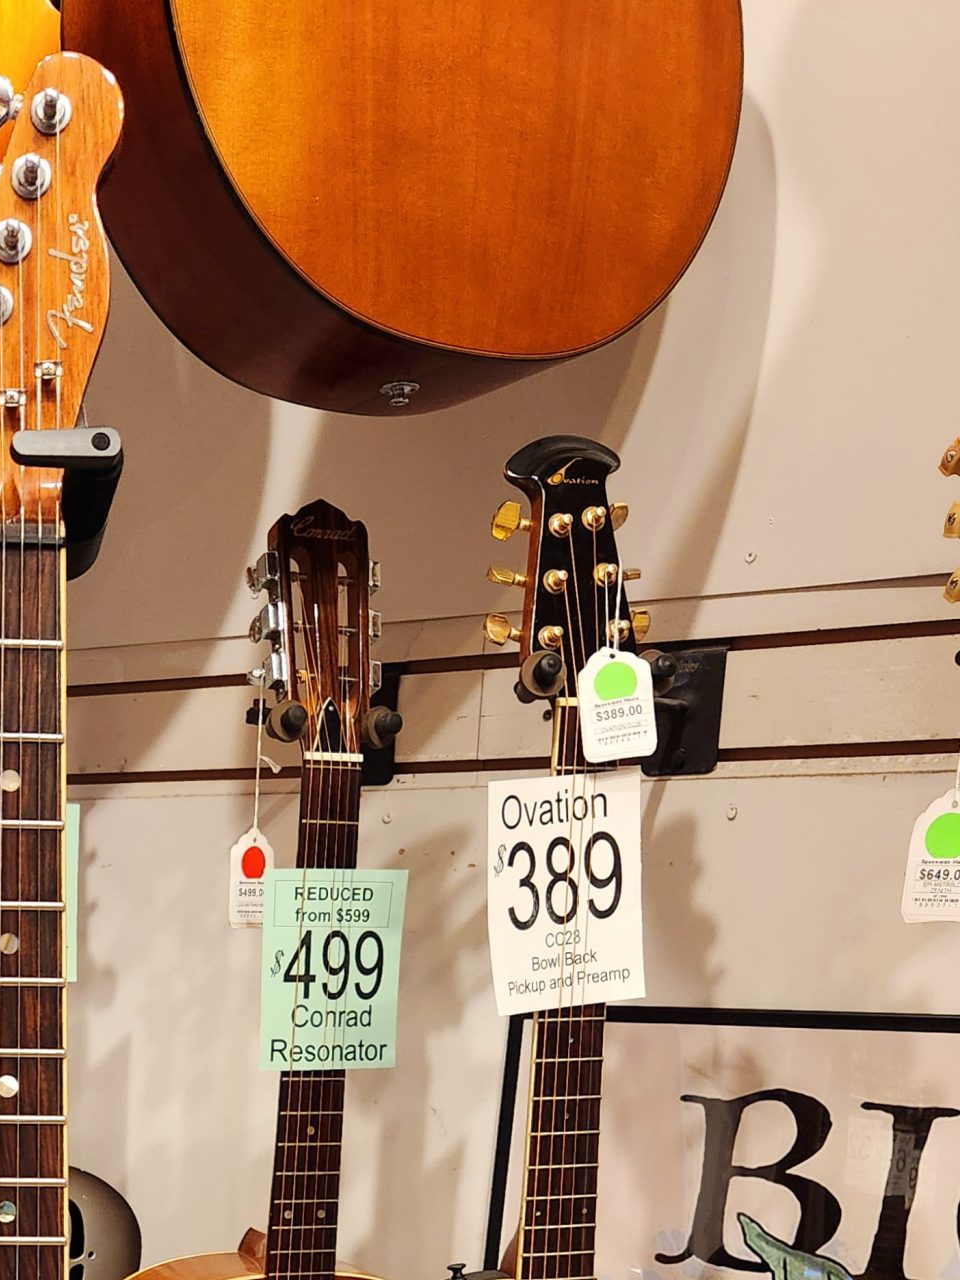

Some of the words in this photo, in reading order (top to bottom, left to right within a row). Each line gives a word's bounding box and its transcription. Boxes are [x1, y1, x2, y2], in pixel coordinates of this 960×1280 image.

[47, 219, 94, 349] Fender
[291, 516, 355, 541] Conrad
[596, 704, 643, 722] $389.00
[501, 788, 608, 830] Ovation
[294, 886, 374, 902] REDUCED
[295, 908, 331, 923] from
[336, 908, 370, 923] $599
[545, 929, 581, 948] CC28
[531, 955, 561, 972] Bowl
[564, 949, 598, 967] Back
[508, 978, 546, 997] Pickup
[549, 971, 573, 990] and
[577, 967, 631, 986] Preamp
[291, 1004, 373, 1028] Conrad
[270, 1038, 388, 1062] Resonator
